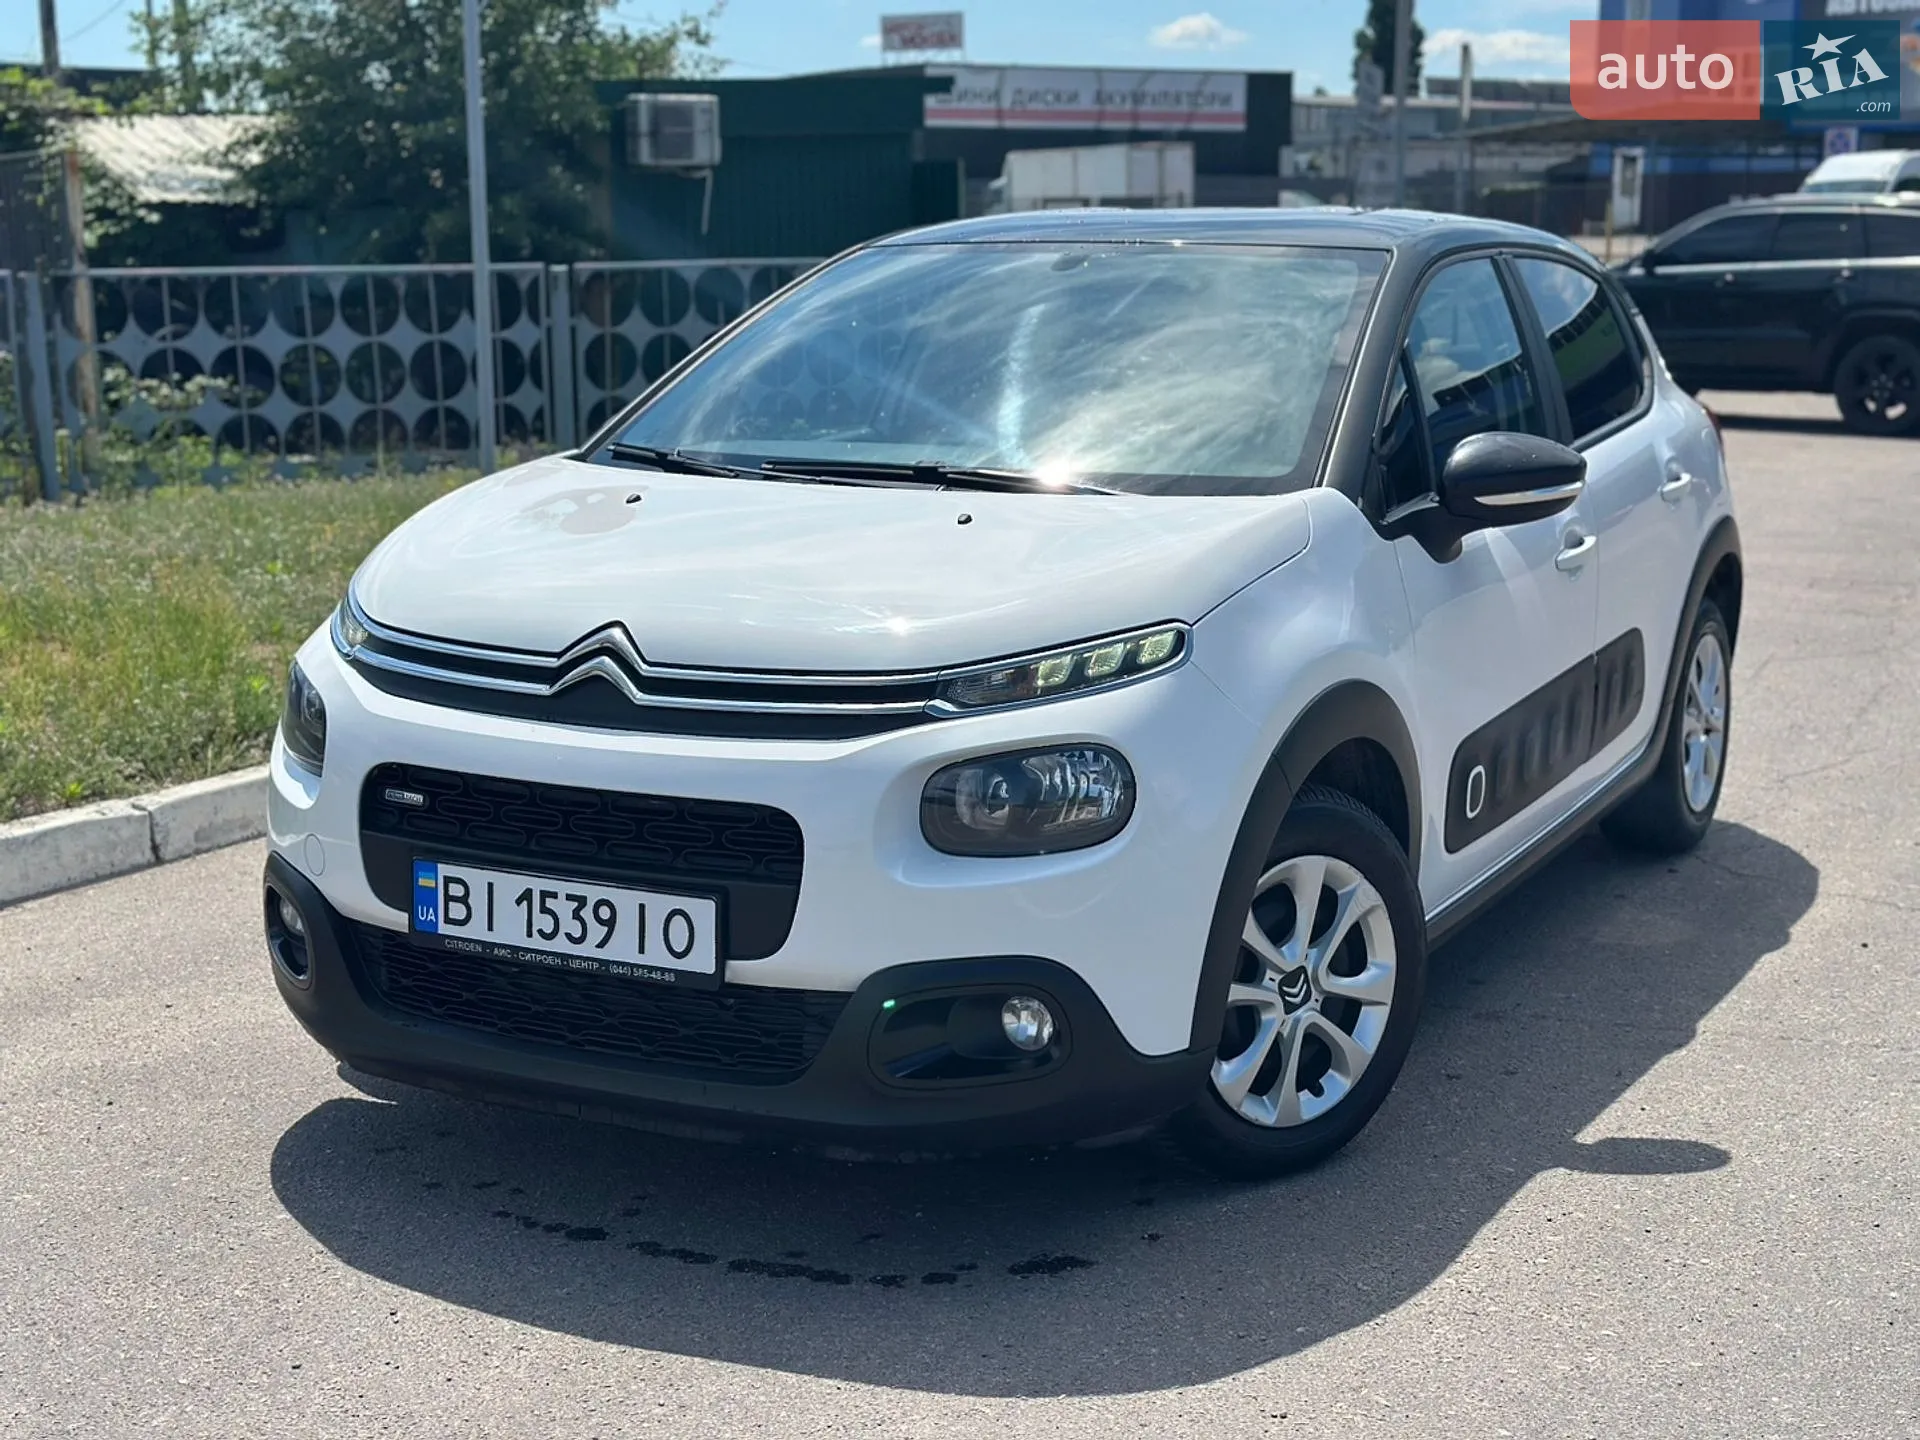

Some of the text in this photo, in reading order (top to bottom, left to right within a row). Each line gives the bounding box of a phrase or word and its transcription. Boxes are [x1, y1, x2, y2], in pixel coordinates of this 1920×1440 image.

[418, 905, 436, 922] UA
[442, 875, 494, 932] BI
[514, 887, 618, 949] 1539
[518, 951, 561, 965] СИТРОЕН
[569, 959, 600, 970] ЦЕНТР
